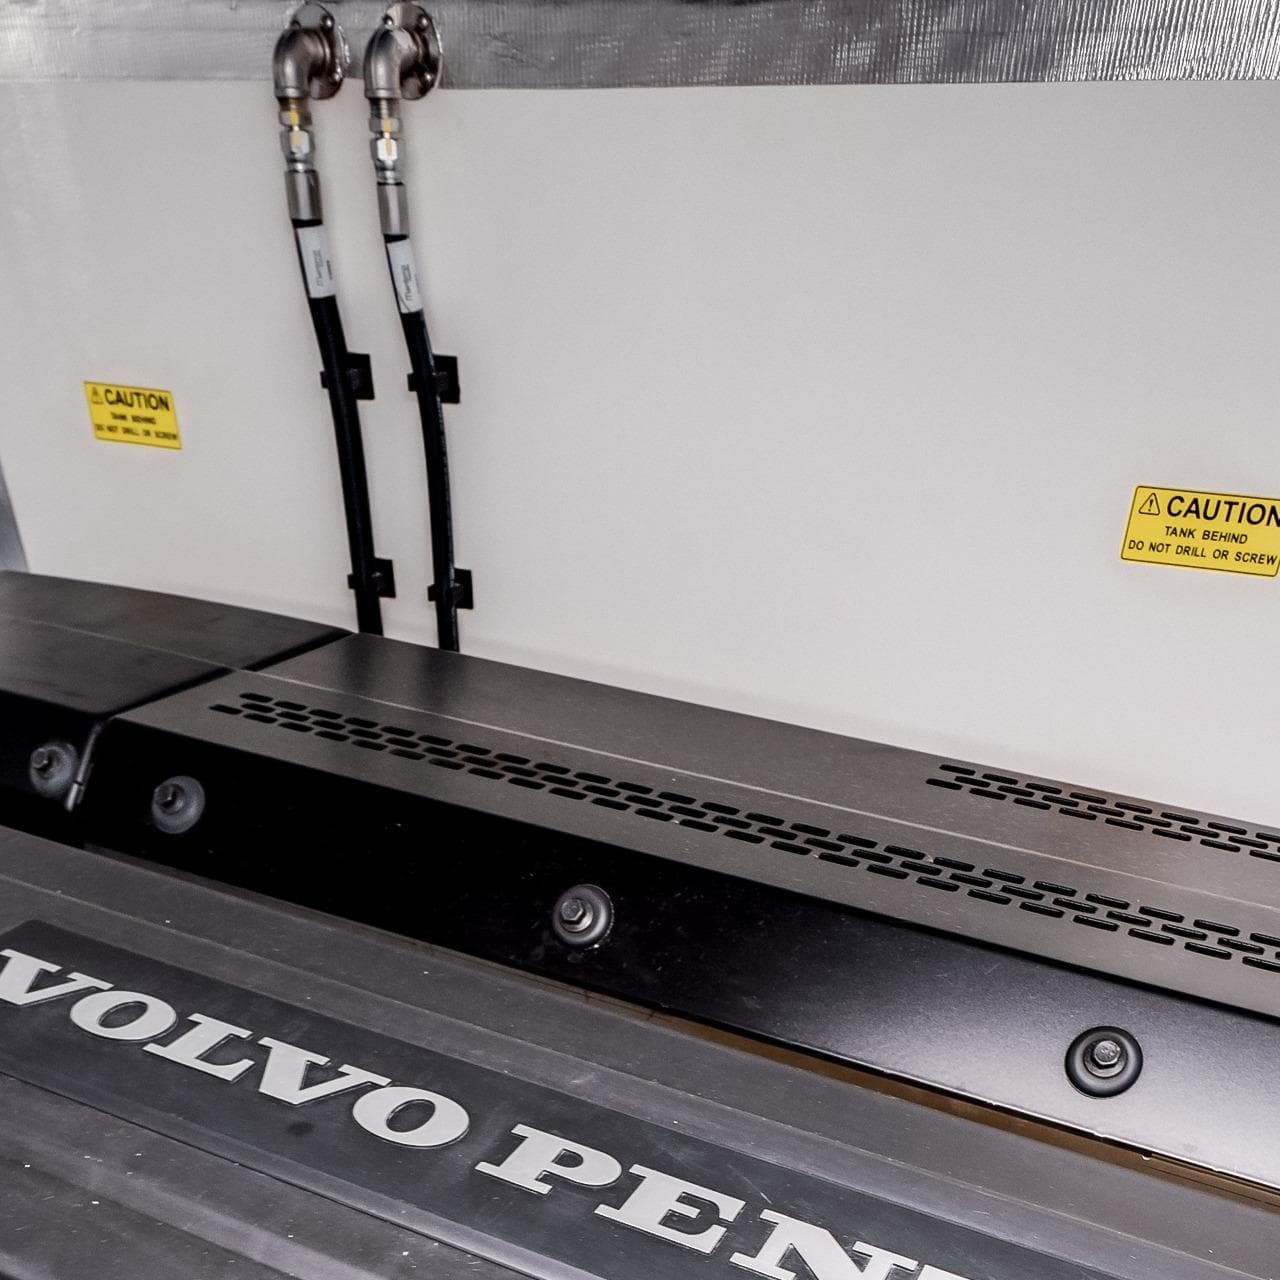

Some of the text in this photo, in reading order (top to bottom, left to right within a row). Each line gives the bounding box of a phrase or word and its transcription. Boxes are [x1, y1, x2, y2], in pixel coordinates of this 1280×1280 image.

[104, 388, 170, 412] CAUTION
[1164, 525, 1249, 545] TANK BEHIND
[1128, 539, 1278, 566] DO NOT DRILL OR SCREW
